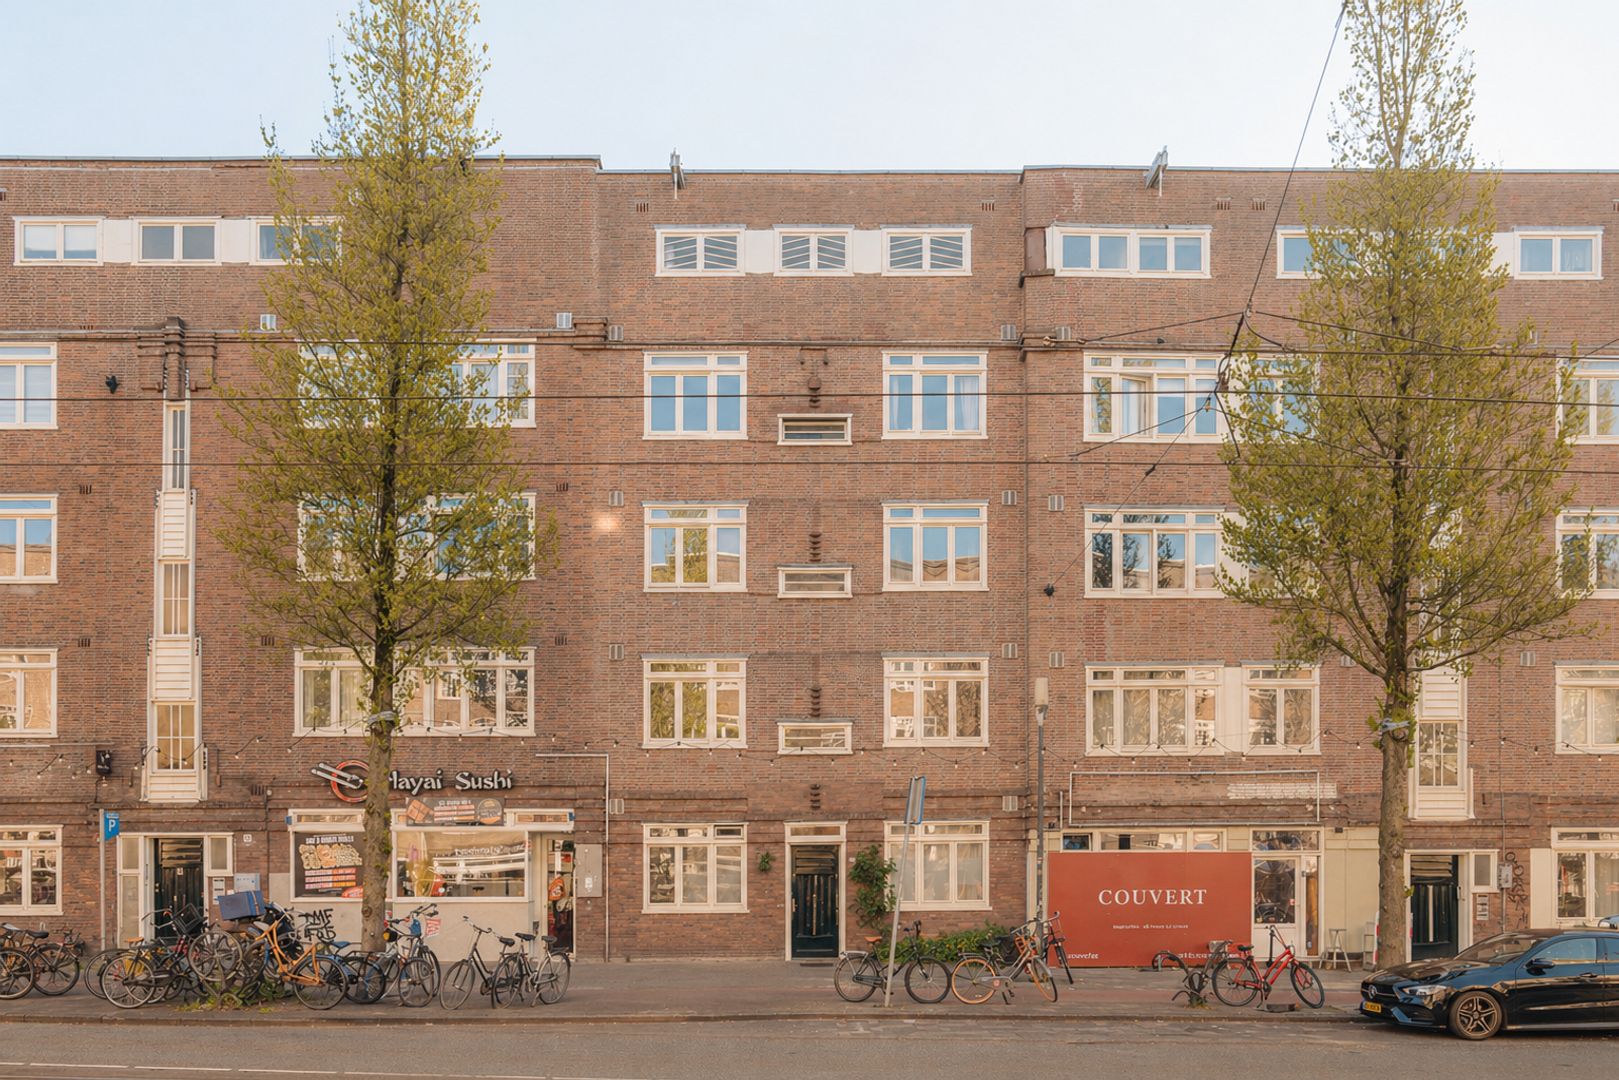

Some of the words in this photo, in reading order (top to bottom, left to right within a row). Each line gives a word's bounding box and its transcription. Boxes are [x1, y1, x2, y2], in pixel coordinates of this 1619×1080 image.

[455, 768, 513, 790] Sushi
[108, 819, 116, 832] P
[1098, 889, 1207, 905] COUVERT
